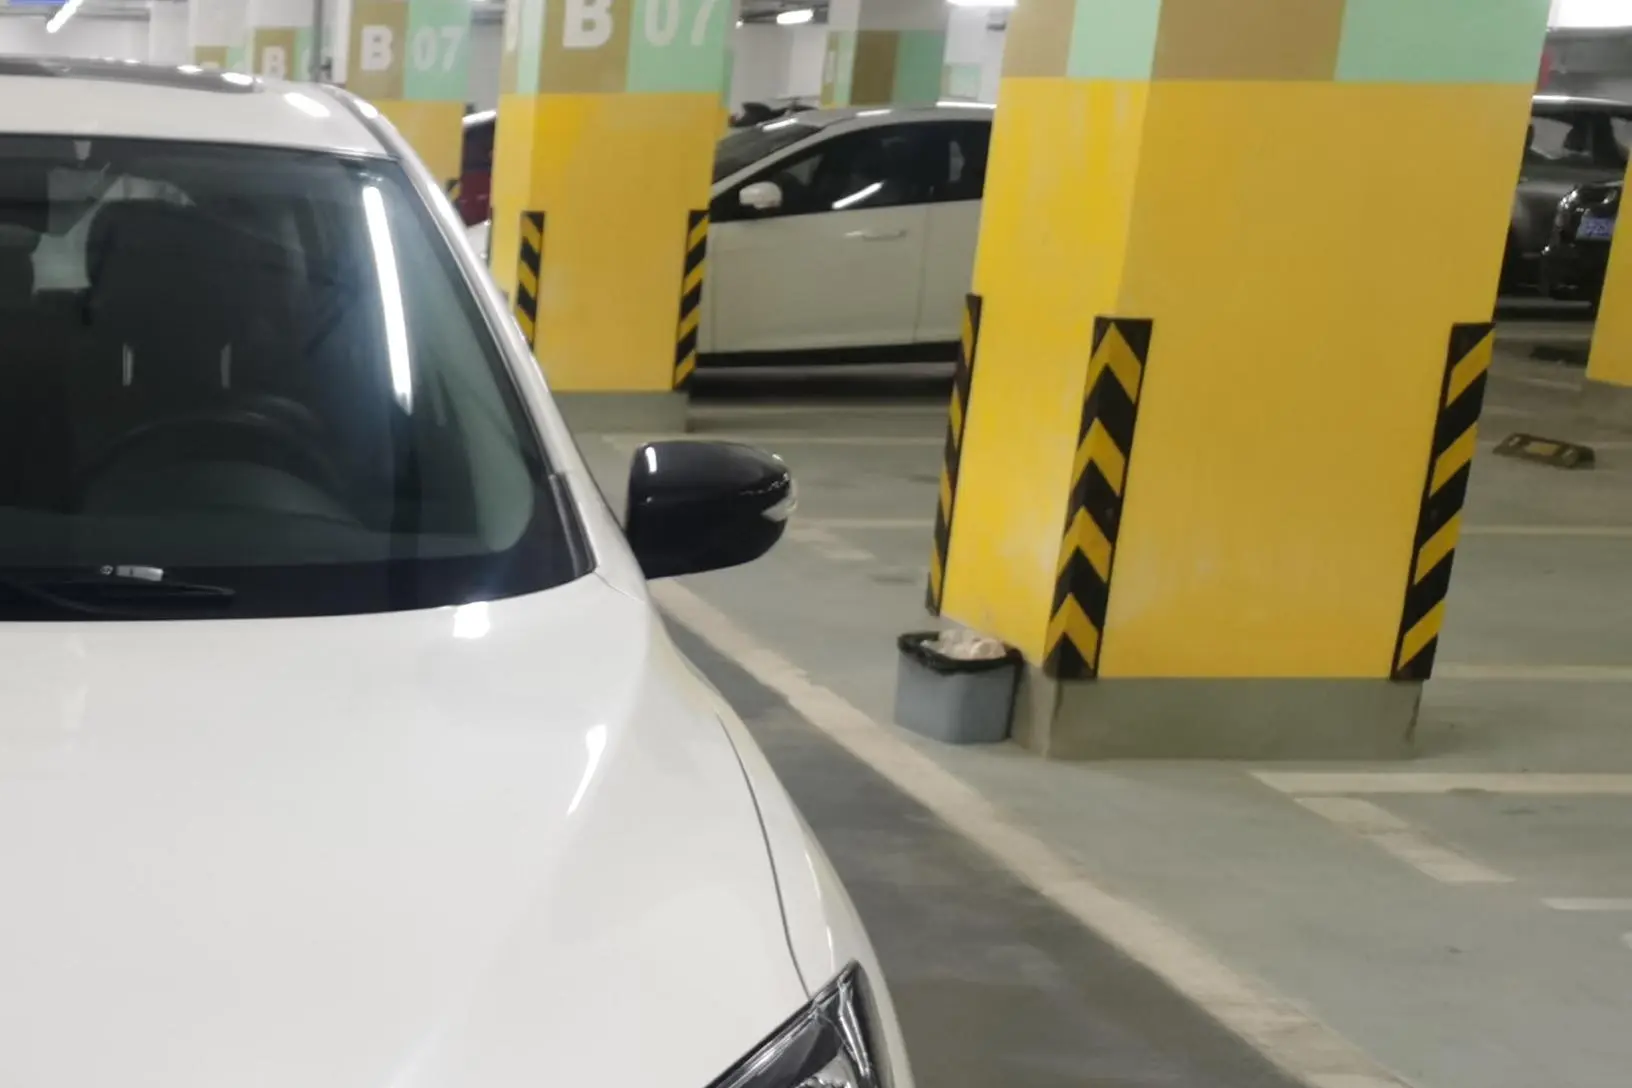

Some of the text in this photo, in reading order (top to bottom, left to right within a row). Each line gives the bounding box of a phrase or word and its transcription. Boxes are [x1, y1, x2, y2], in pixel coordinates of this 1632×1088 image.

[563, 0, 615, 48] B
[644, 0, 715, 47] 07
[361, 25, 393, 71] B
[411, 25, 466, 72] 07
